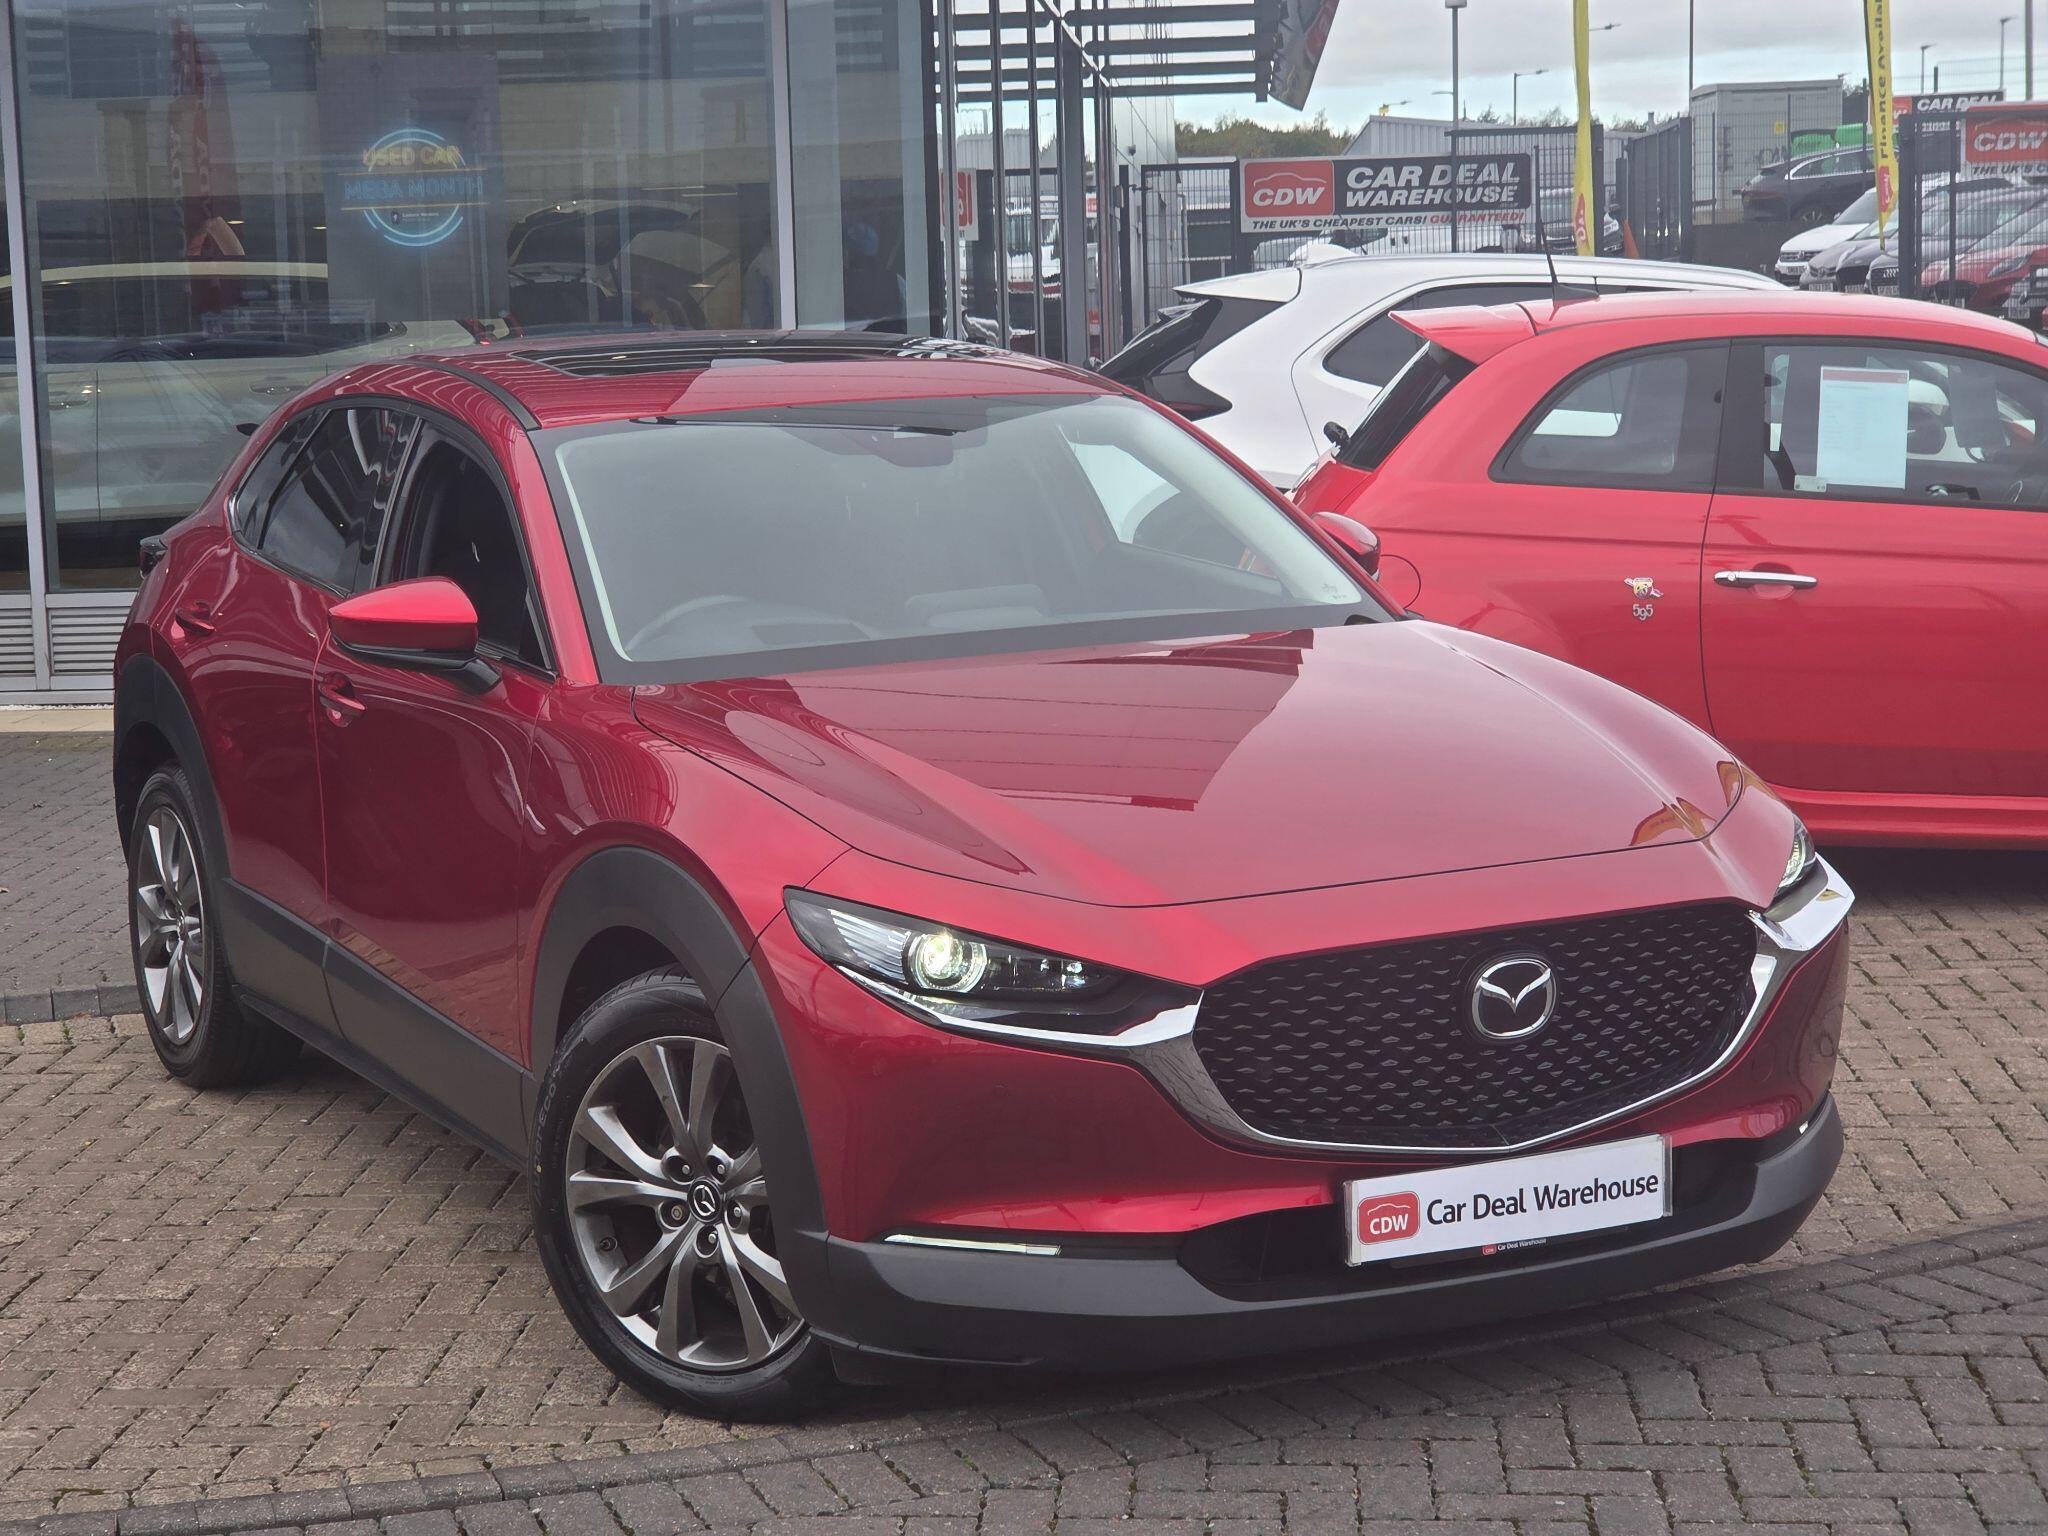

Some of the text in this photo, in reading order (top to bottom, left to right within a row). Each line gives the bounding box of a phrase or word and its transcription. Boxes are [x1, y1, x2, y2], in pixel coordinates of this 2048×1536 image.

[1917, 98, 1953, 112] CAR
[1878, 76, 1889, 159] Finance
[1974, 132, 2048, 152] CDW
[362, 147, 415, 166] USED
[1347, 162, 1520, 189] CAR DEAL
[344, 175, 484, 199] MEGA MONTH
[1252, 187, 1325, 206] CDW
[1347, 186, 1518, 207] WAREHOUSE
[1253, 220, 1276, 230] THE
[1279, 219, 1309, 229] UK'S
[1312, 217, 1383, 228] CHEAPEST
[1385, 215, 1427, 225] CARS!
[1427, 1174, 1658, 1226] Car Deal Warehouse
[1369, 1213, 1408, 1236] CDW
